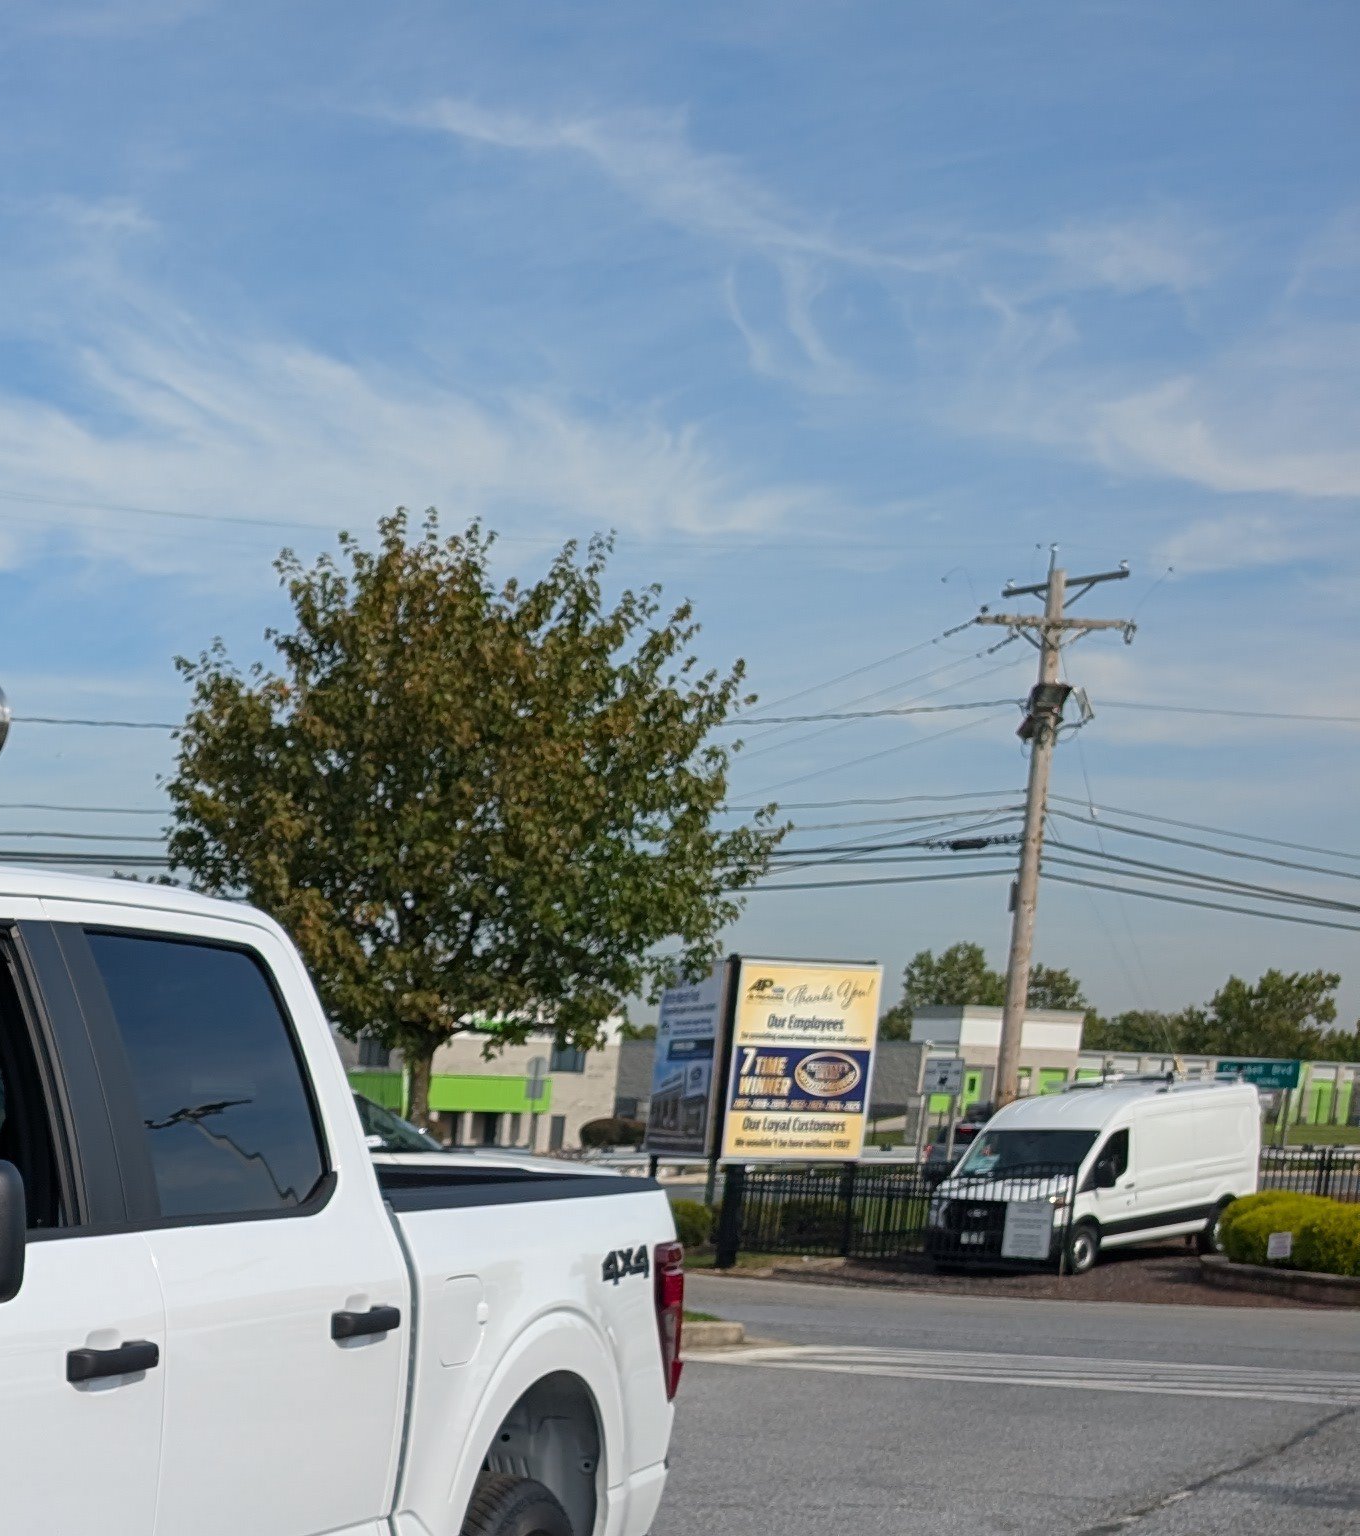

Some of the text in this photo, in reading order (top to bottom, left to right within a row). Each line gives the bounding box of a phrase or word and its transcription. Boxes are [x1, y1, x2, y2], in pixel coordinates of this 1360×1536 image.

[786, 979, 875, 1010] Thanks You!
[767, 1013, 844, 1031] Our Employees
[740, 1048, 757, 1075] 7
[755, 1056, 788, 1076] TIME
[739, 1077, 792, 1097] WINNER
[742, 1116, 846, 1134] Our Loyal Customers
[735, 1138, 745, 1146] We
[745, 1138, 778, 1147] wouldn't
[778, 1139, 787, 1147] be
[787, 1140, 803, 1148] here
[804, 1139, 832, 1148] without
